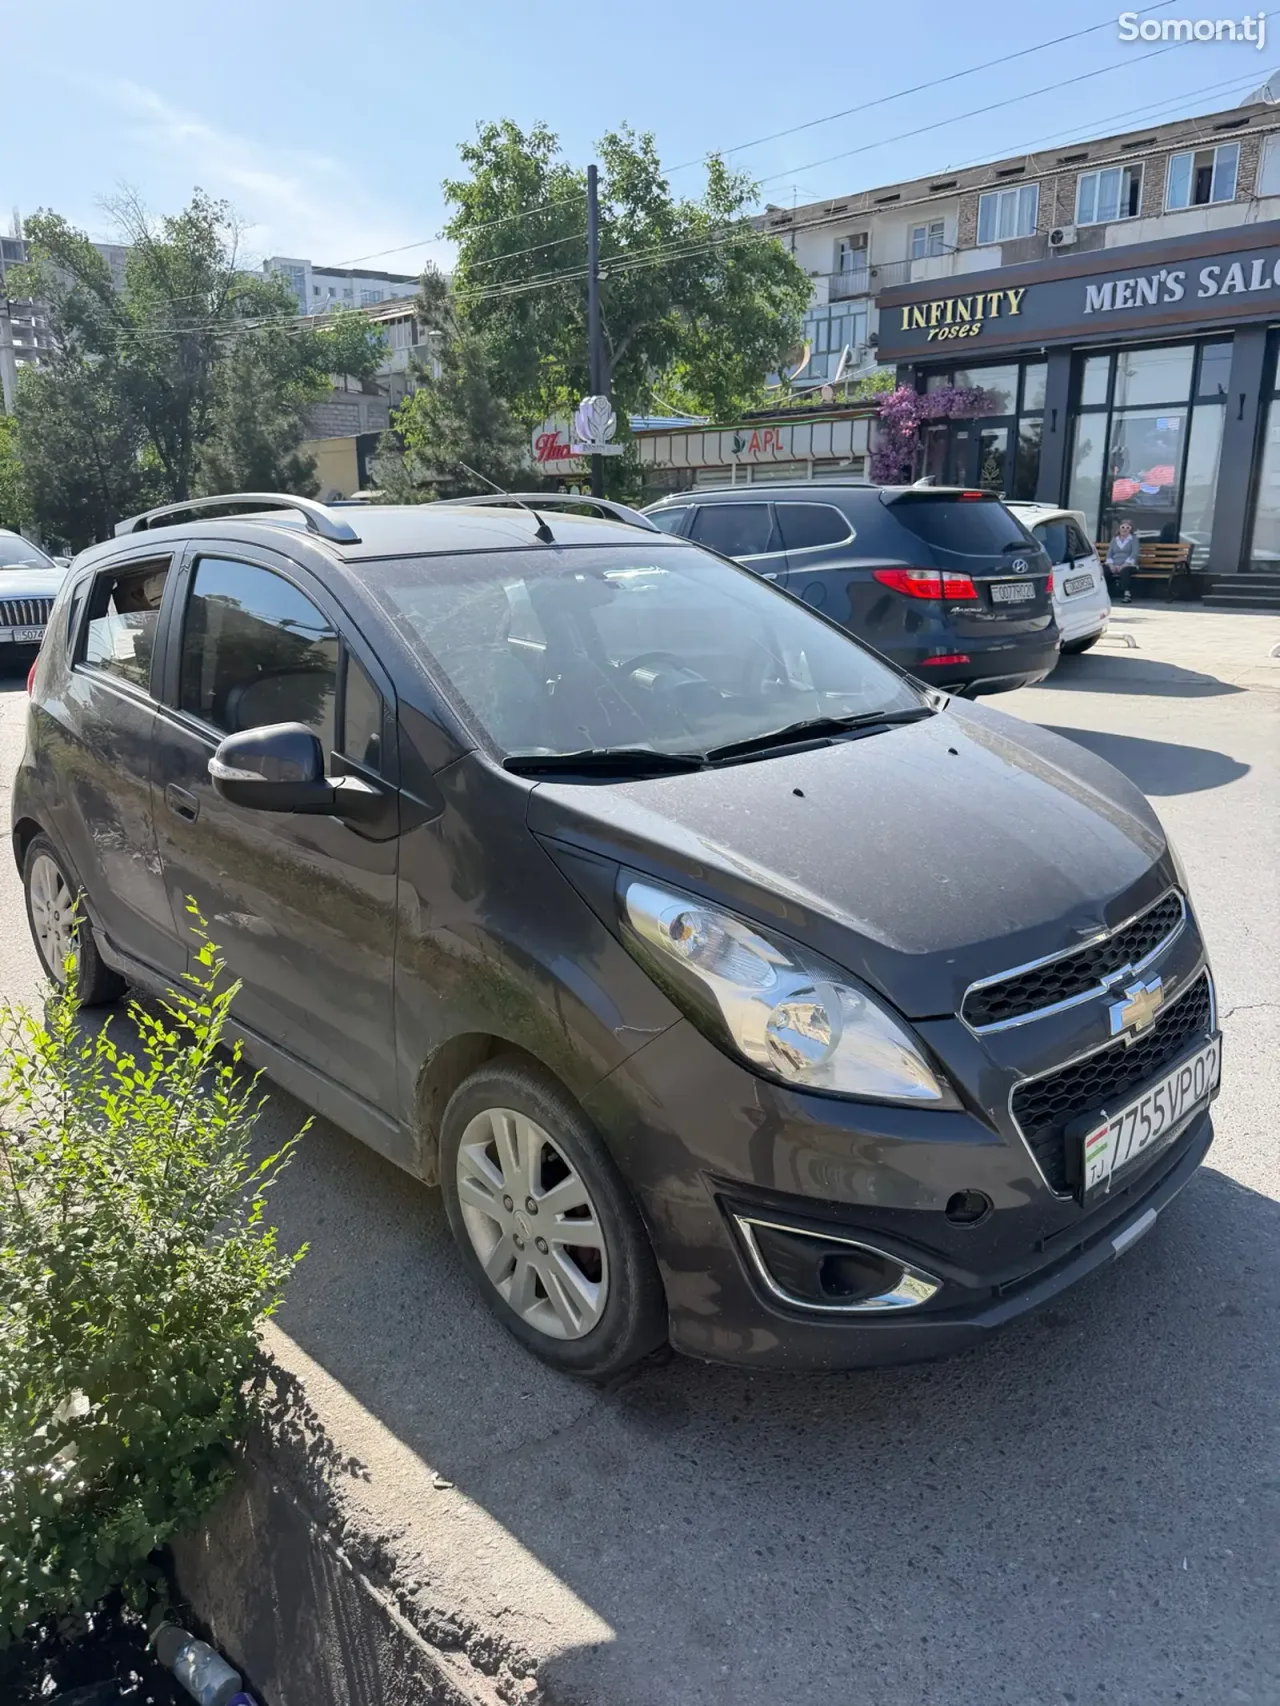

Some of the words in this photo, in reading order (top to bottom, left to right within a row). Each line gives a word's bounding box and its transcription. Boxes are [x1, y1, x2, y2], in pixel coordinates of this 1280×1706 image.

[1083, 269, 1186, 314] MEN'S
[1197, 258, 1280, 298] SAL
[900, 288, 1026, 331] INFINITY
[926, 322, 982, 342] roses
[748, 428, 784, 453] APL
[22, 630, 46, 640] 5074
[1109, 1047, 1217, 1170] 7755VP02
[1090, 1159, 1105, 1184] TJ
